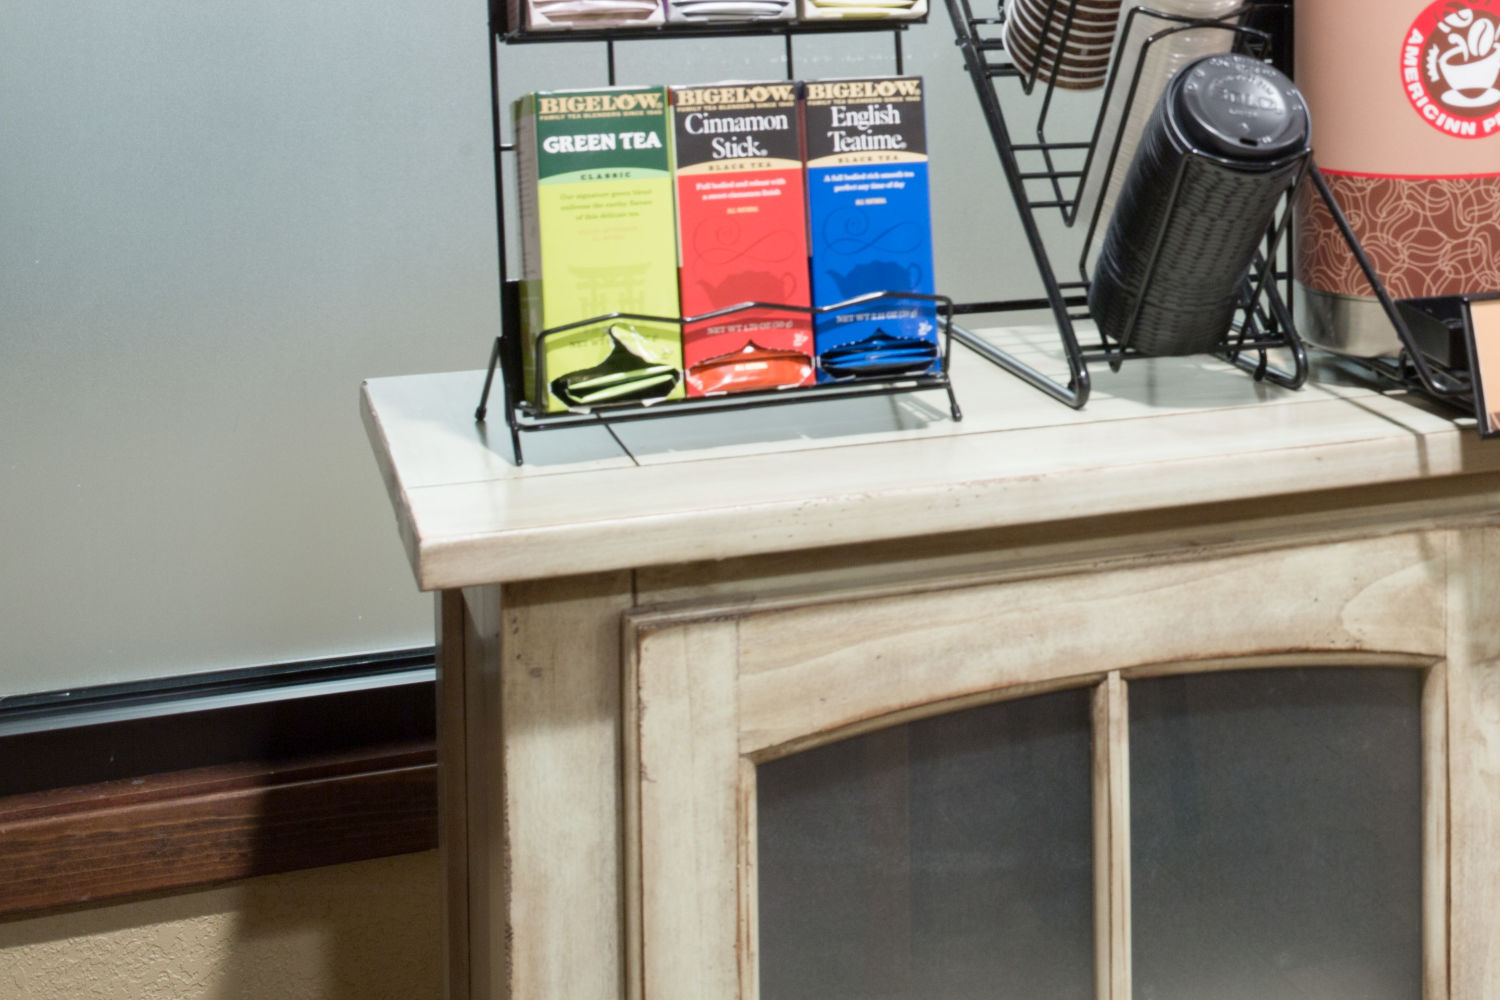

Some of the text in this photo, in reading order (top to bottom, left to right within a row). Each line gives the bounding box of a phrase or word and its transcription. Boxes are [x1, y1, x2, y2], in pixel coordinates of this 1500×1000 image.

[807, 80, 921, 100] BIGELOW
[1403, 28, 1476, 135] AMERICINN
[539, 93, 663, 114] BIGELOW
[677, 85, 795, 106] BIGELOW
[684, 112, 789, 135] Cinnamon
[830, 104, 901, 130] English
[543, 131, 662, 154] GREEN TEA
[711, 135, 764, 159] Stick
[827, 129, 904, 152] Teatime
[580, 172, 632, 181] CLASSIC
